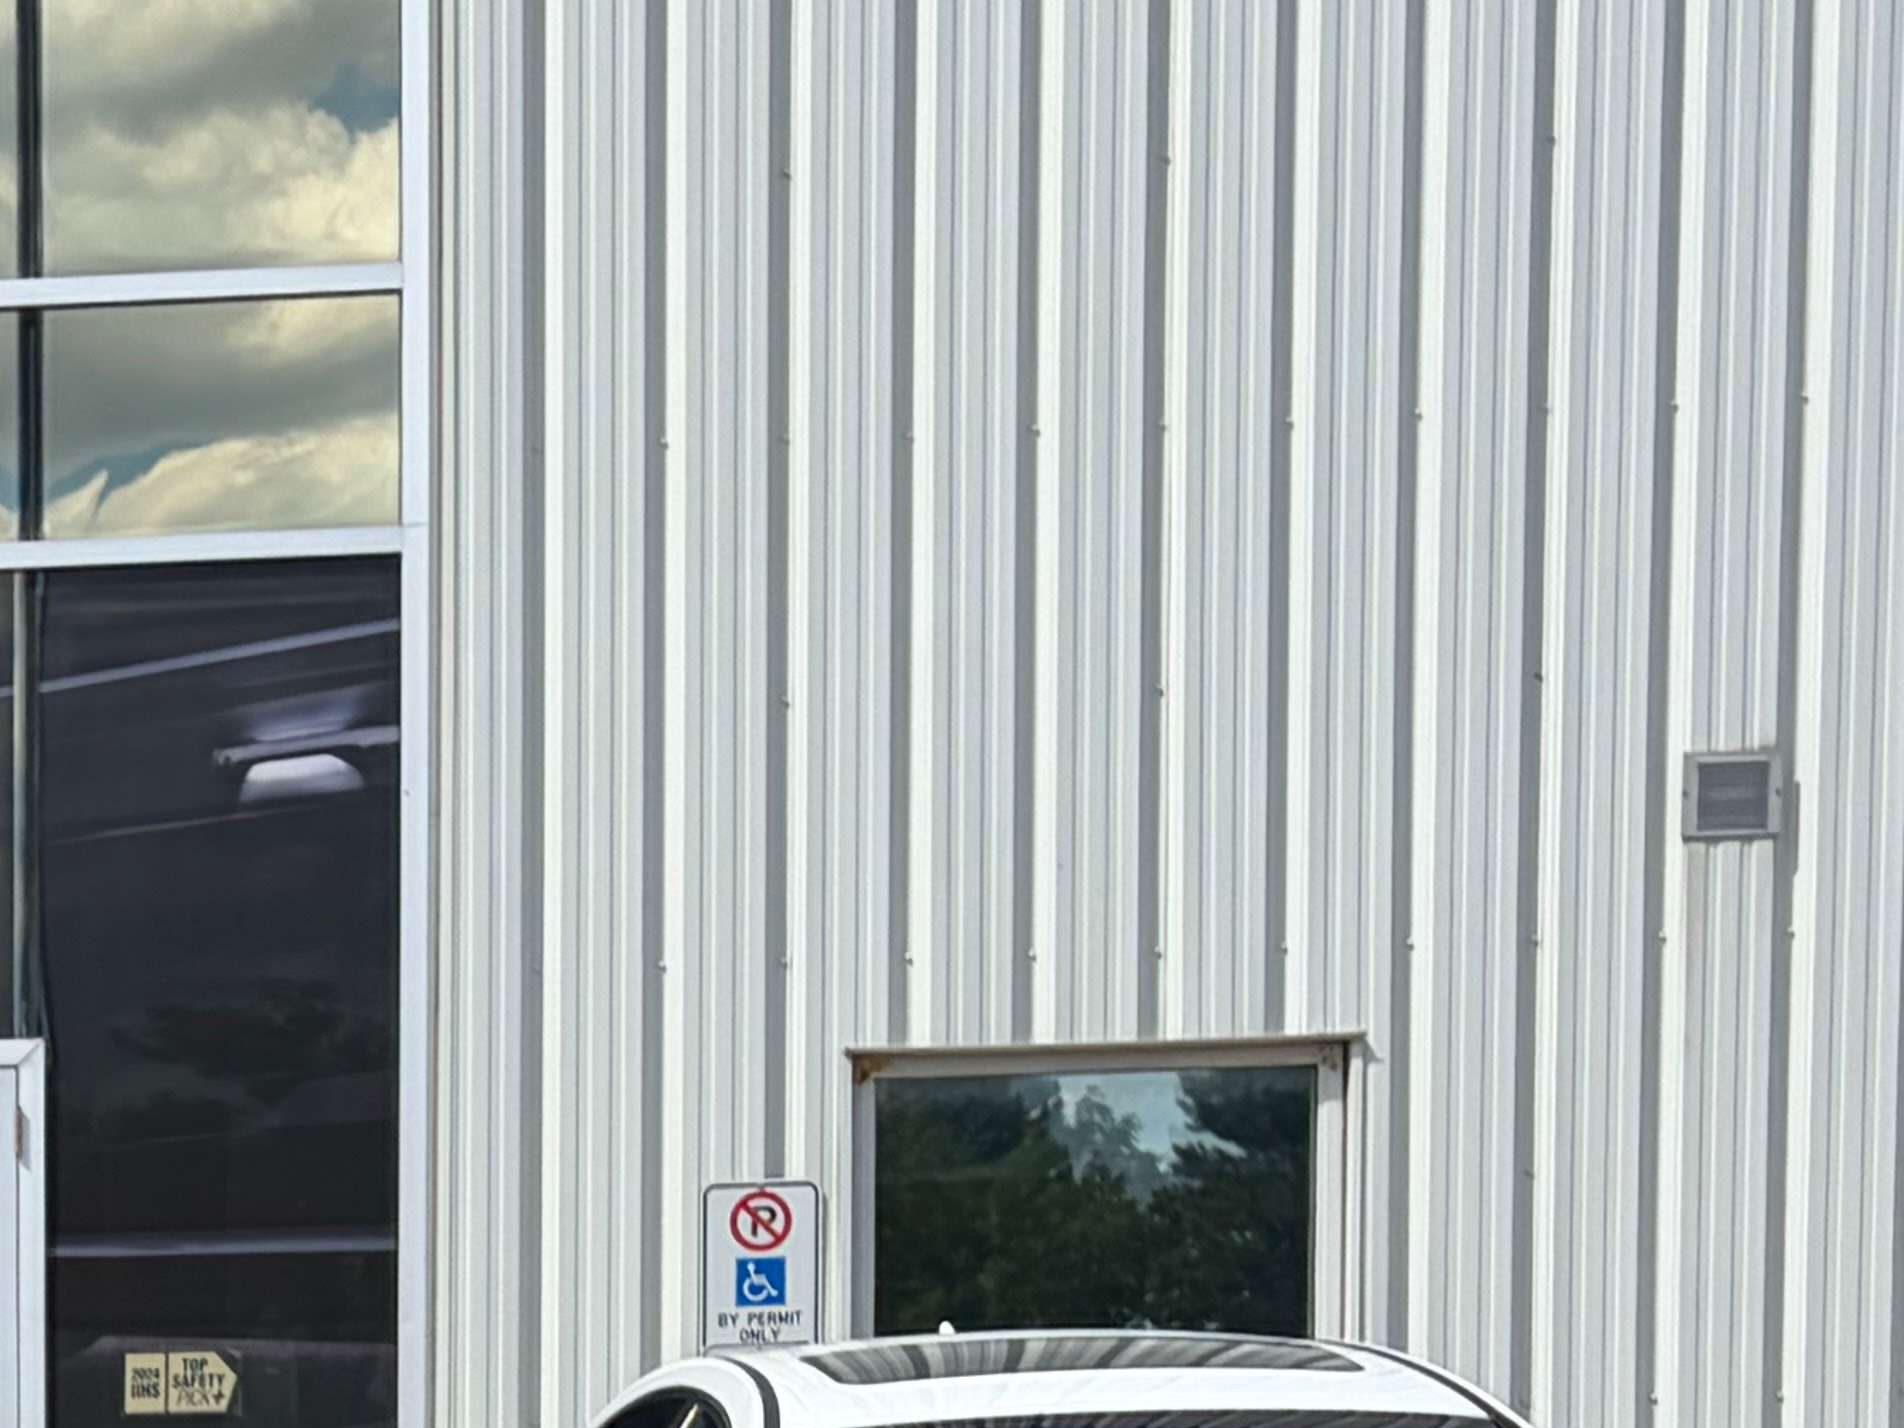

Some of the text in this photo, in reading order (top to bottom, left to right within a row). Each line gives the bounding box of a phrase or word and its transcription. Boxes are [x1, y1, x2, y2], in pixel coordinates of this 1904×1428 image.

[717, 1310, 802, 1328] BY PERMIT
[739, 1328, 781, 1343] ONLY
[181, 1357, 209, 1372] TOP
[172, 1373, 226, 1389] SAFETY
